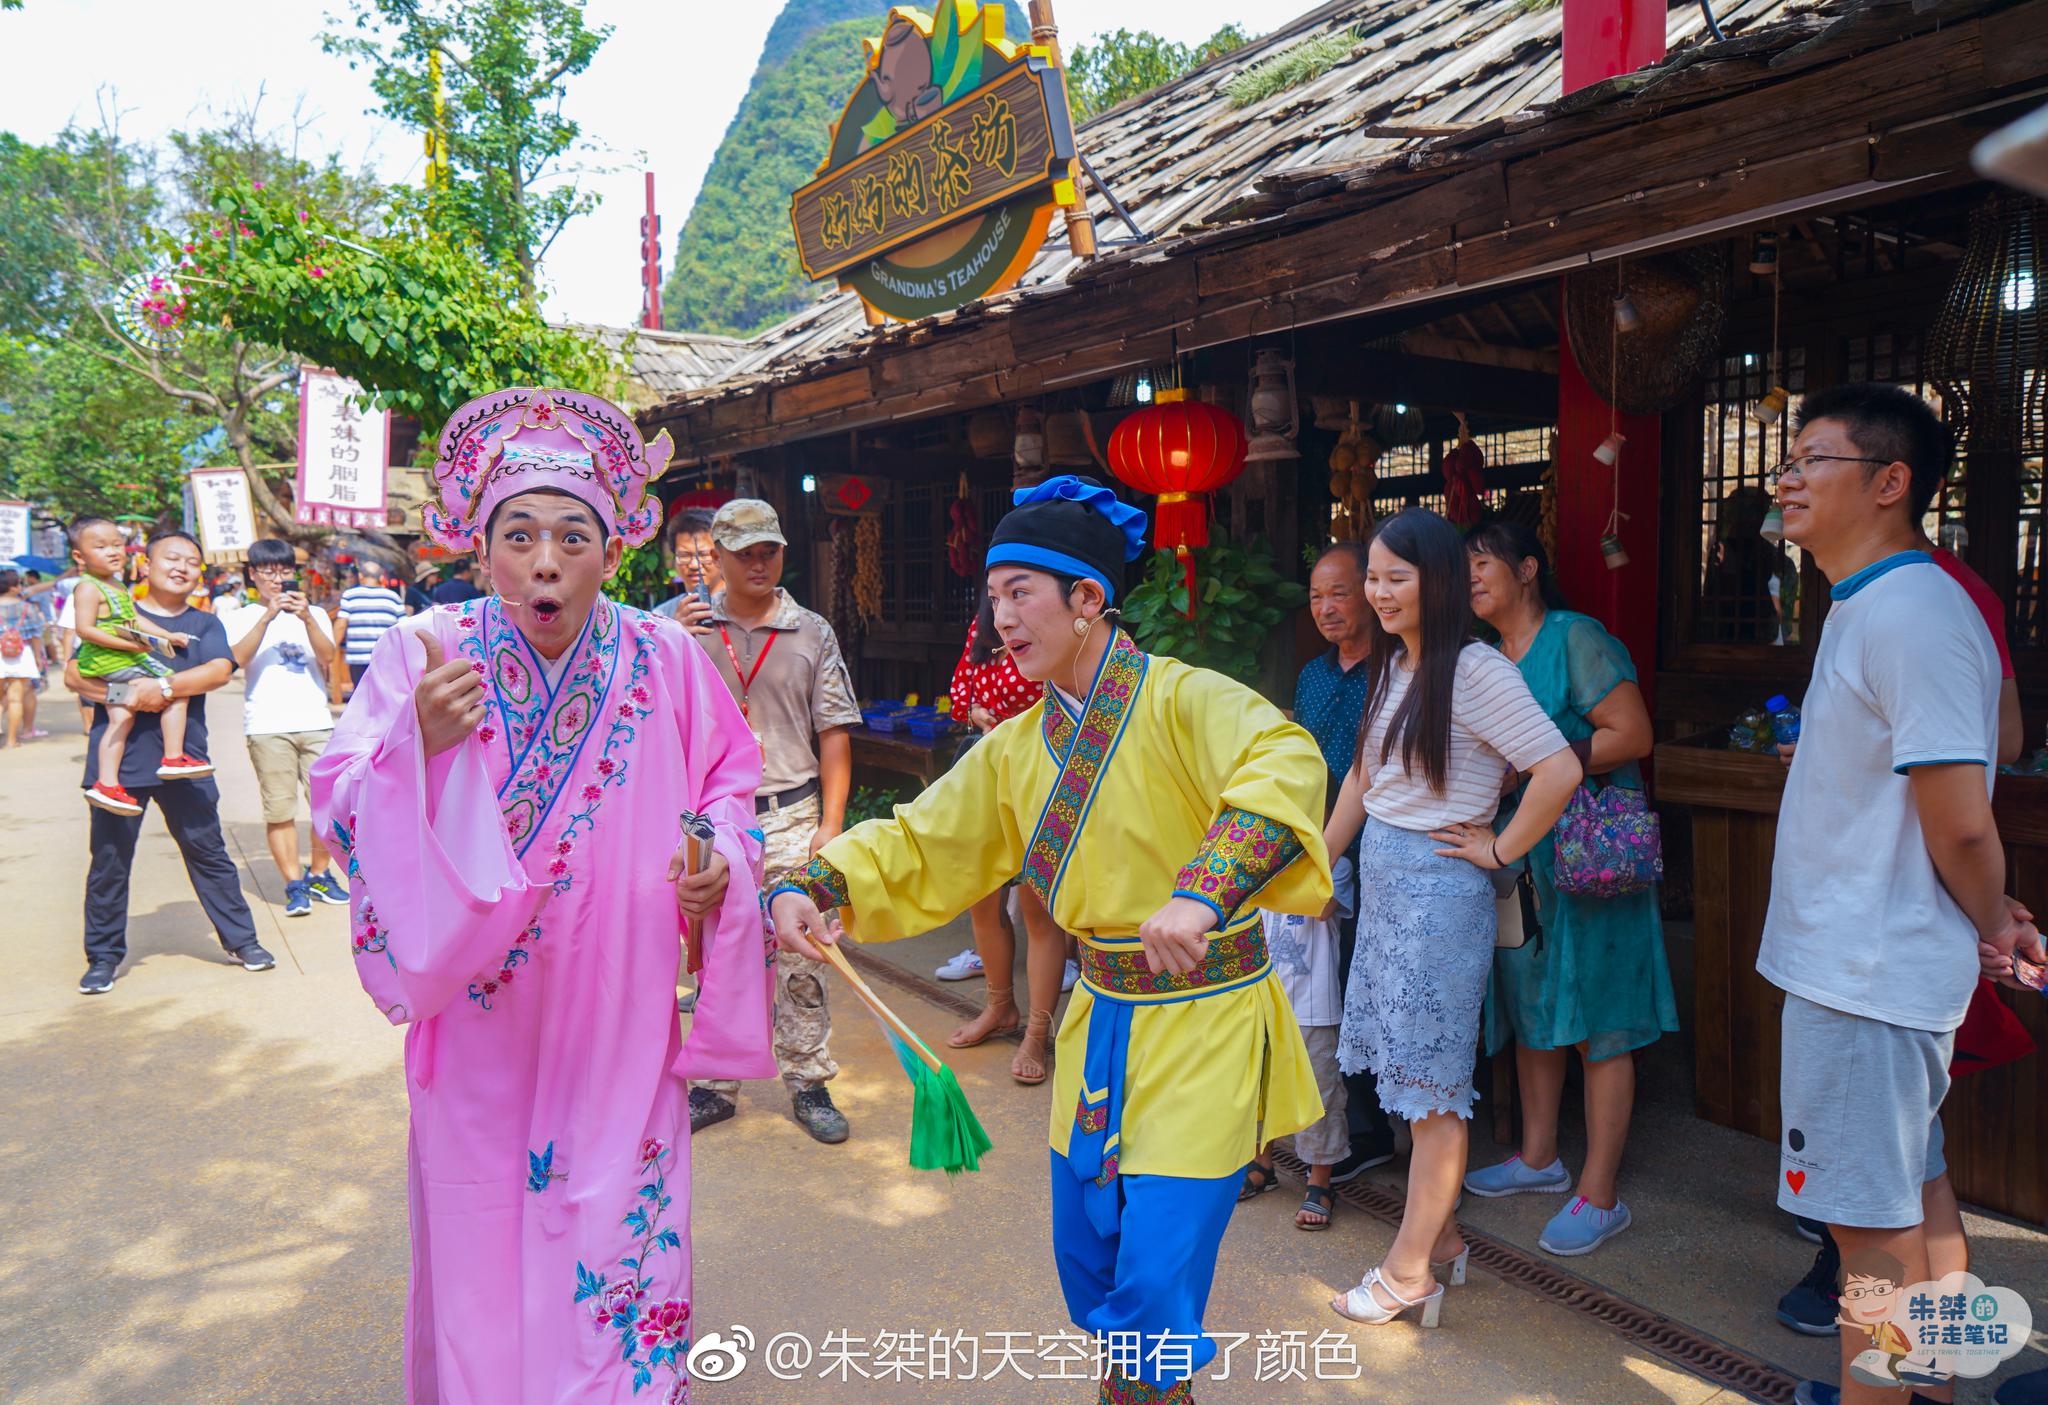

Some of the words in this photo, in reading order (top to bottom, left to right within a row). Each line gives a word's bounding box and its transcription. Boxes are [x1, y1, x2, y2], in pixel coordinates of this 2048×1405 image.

[871, 261, 947, 299] GRANDMA'S
[947, 207, 1012, 291] TEAHOUSE
[328, 404, 362, 502] 表妹的胭脂
